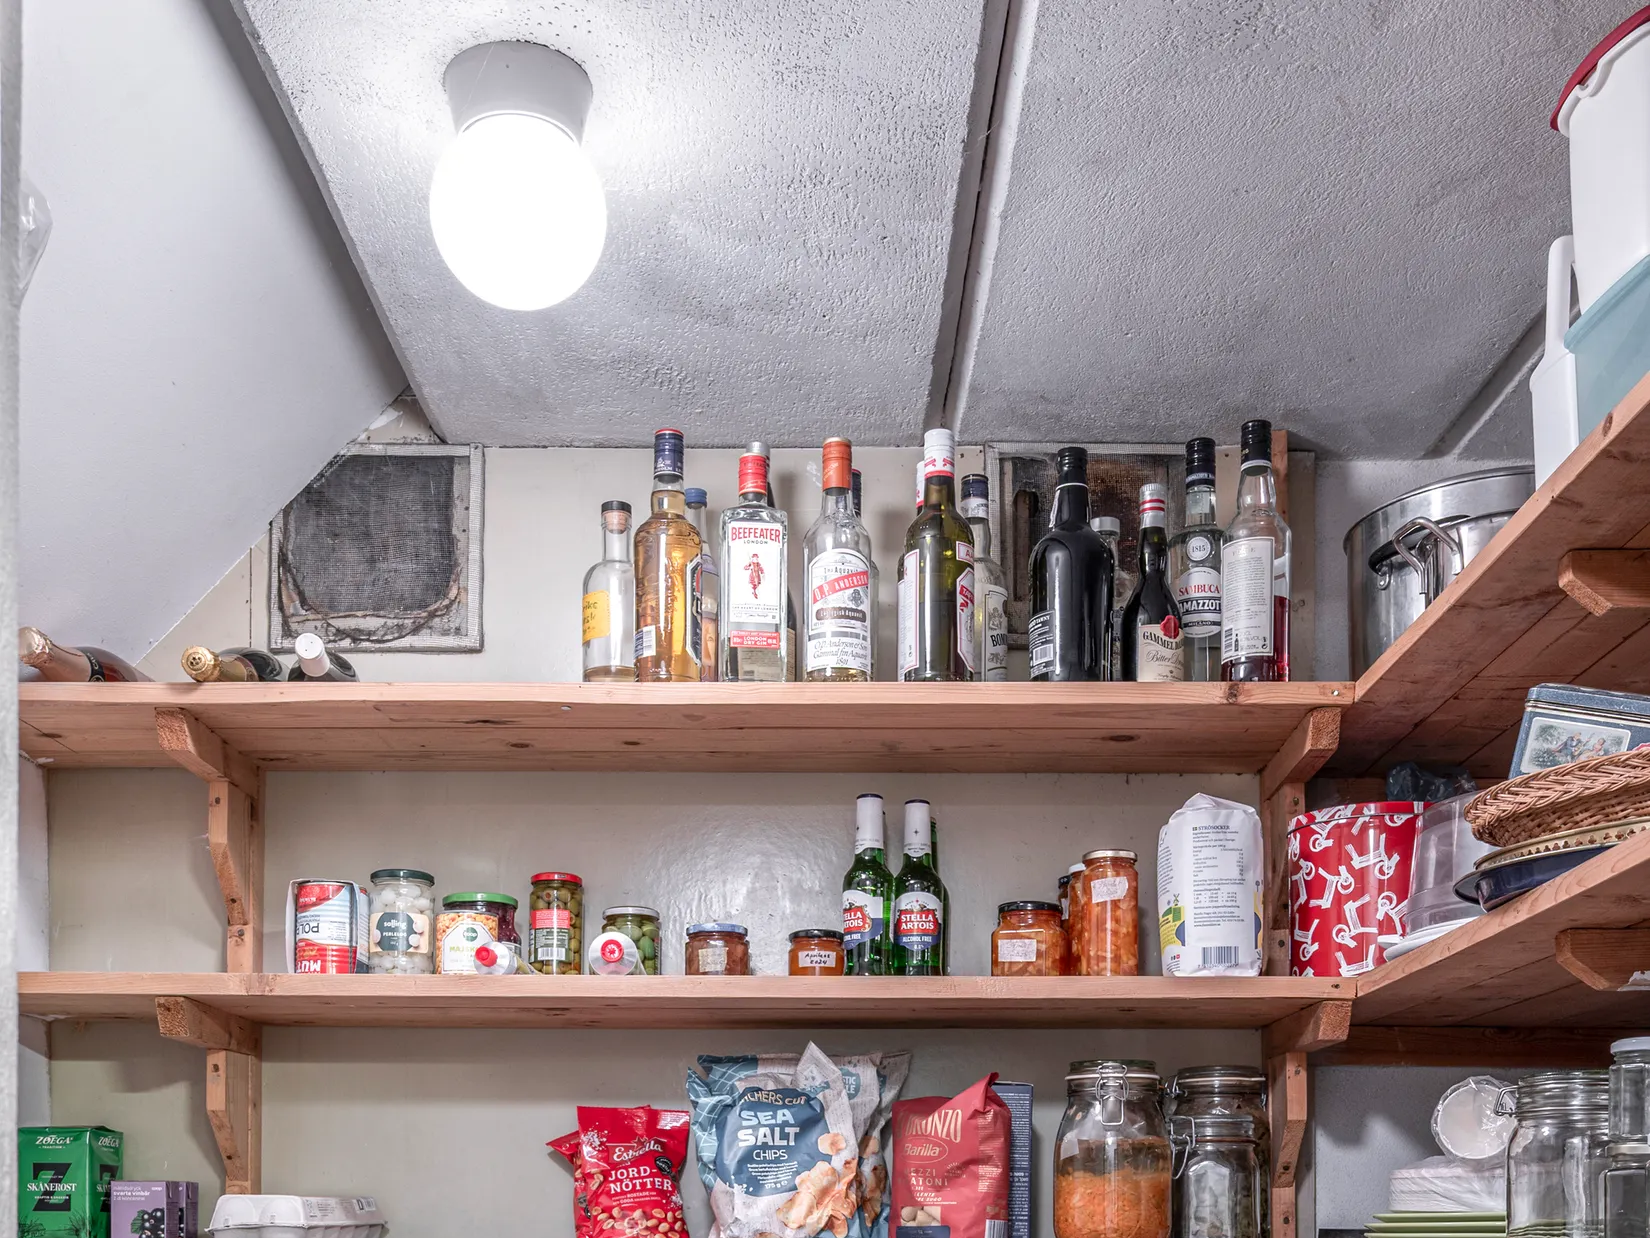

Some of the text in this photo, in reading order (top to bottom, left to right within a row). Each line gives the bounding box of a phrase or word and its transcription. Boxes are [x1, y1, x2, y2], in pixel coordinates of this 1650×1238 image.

[731, 526, 781, 544] BEEFEATER
[1191, 544, 1206, 553] 1815
[1178, 583, 1220, 597] SAMBUCA
[1179, 599, 1221, 611] AMAZZOT
[1142, 630, 1175, 651] GAMMEL
[1145, 650, 1172, 663] Bitter
[901, 913, 934, 922] STELLA
[296, 922, 320, 935] POLP
[383, 919, 407, 930] salling
[901, 921, 934, 930] ARTOIS
[297, 959, 321, 972] MUT
[785, 1095, 807, 1106] CUT
[740, 1108, 795, 1127] SEA
[737, 1126, 800, 1147] SALT
[613, 1139, 663, 1162] Estrella
[752, 1149, 789, 1161] CHIPS
[904, 1143, 940, 1157] Barilla
[608, 1165, 658, 1181] JORD-
[26, 1181, 78, 1192] SKÅNEROST
[609, 1177, 673, 1194] NÖTTER
